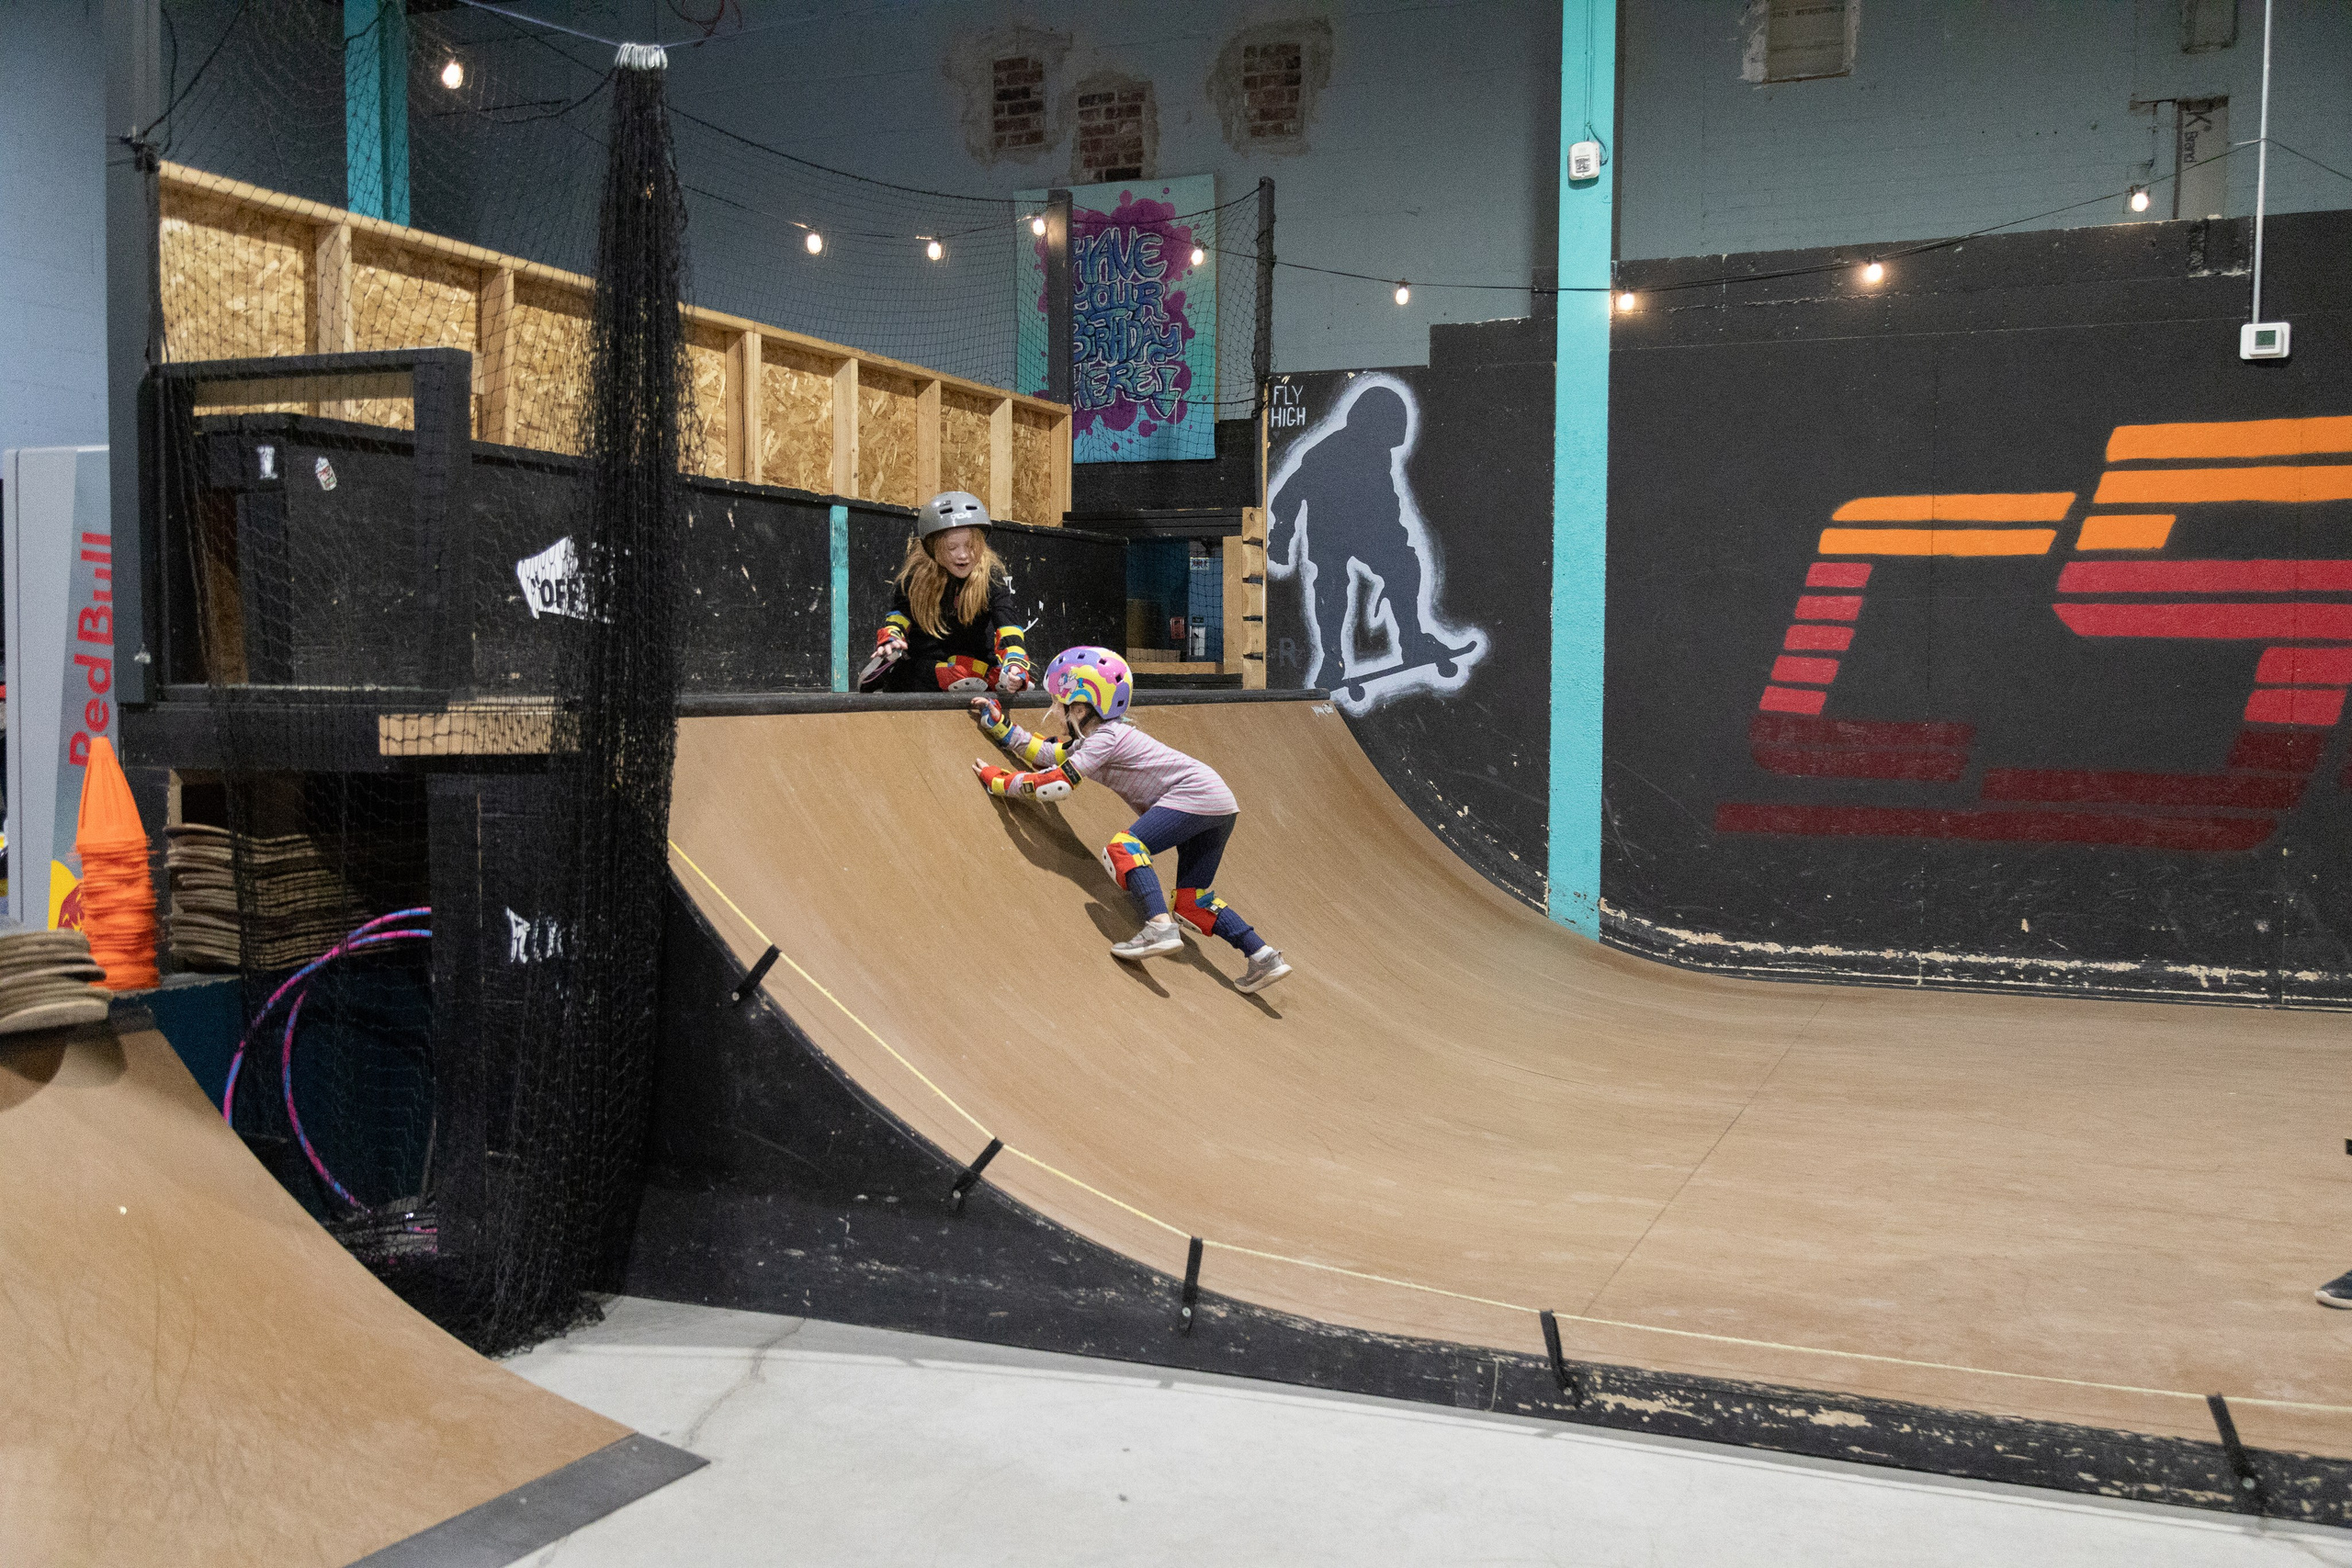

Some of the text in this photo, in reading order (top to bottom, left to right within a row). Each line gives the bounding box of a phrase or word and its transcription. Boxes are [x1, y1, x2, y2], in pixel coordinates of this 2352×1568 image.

[1273, 385, 1304, 405] FLY
[1271, 406, 1306, 428] HIGH
[77, 532, 113, 646] Bull
